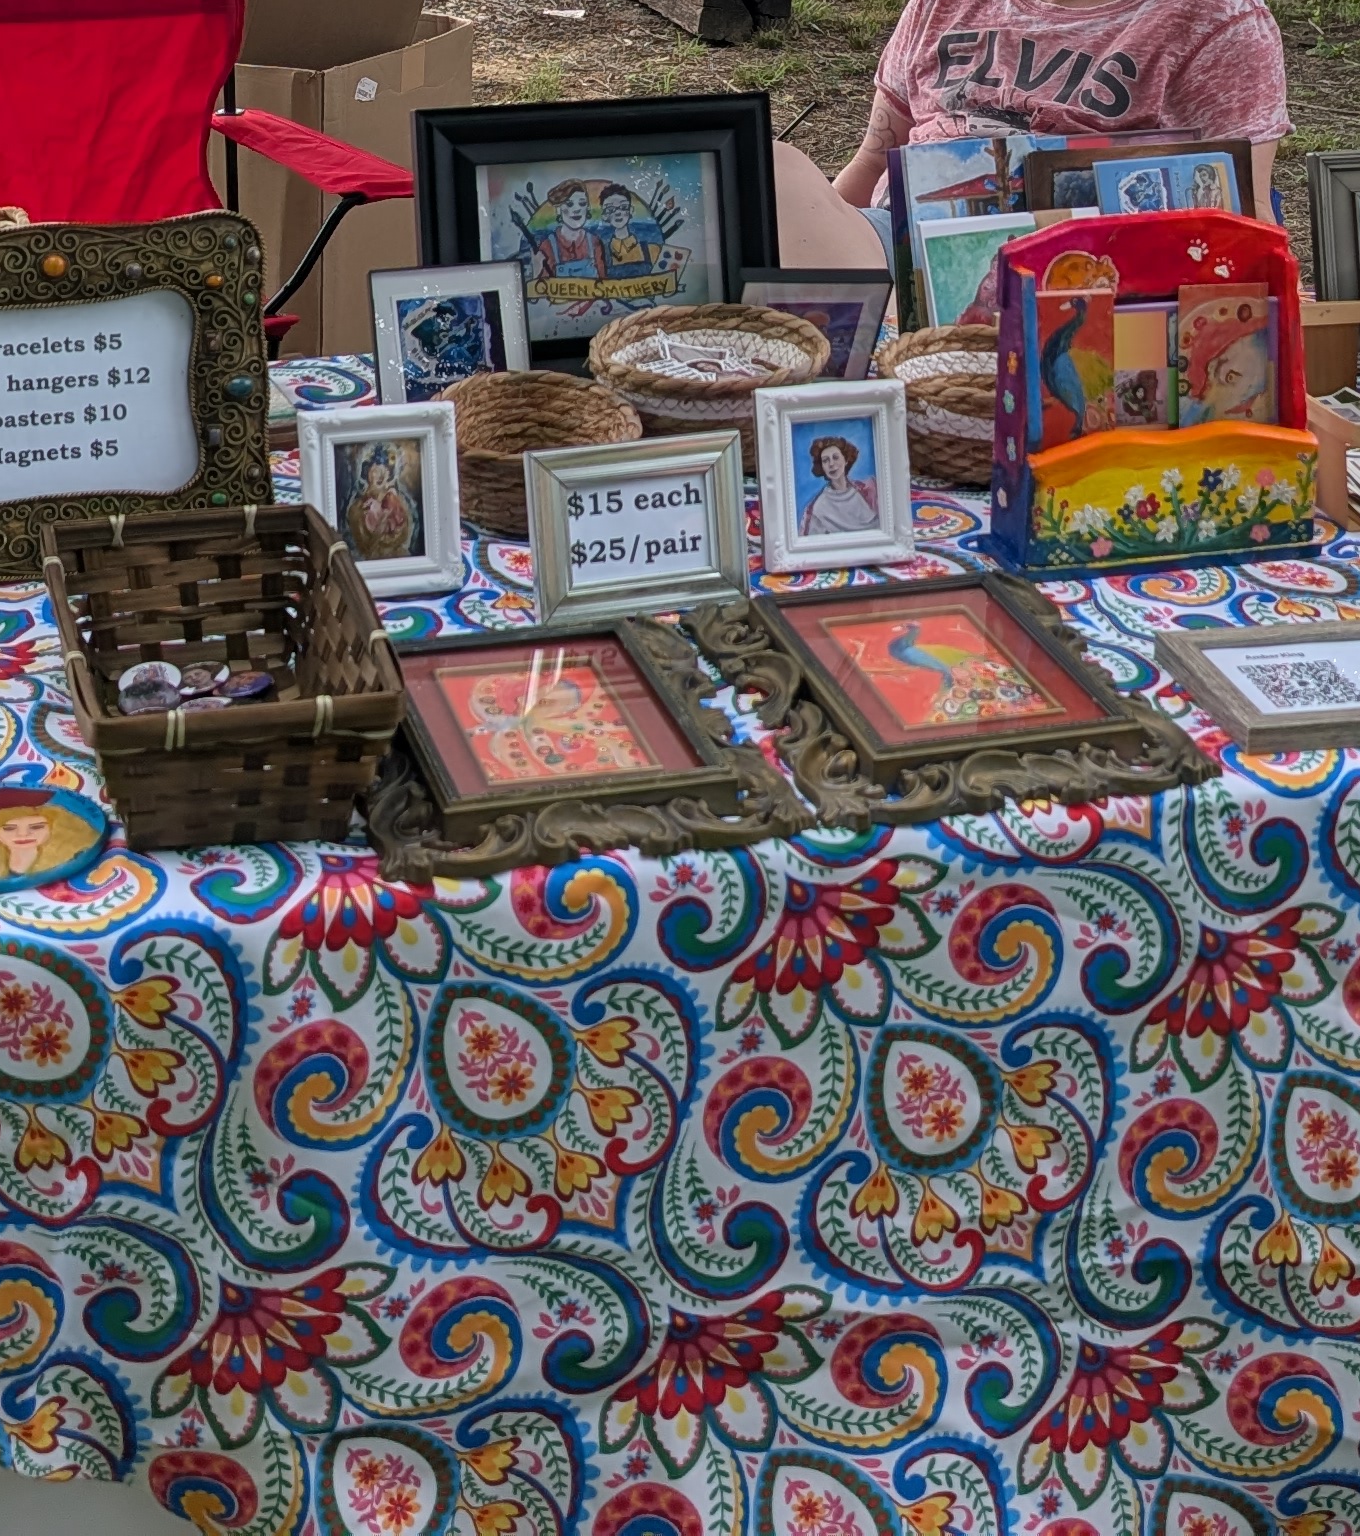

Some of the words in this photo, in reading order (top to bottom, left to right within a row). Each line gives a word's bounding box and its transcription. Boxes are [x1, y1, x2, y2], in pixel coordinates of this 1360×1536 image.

[932, 30, 1138, 118] ELVIS
[535, 277, 588, 296] QUEEN
[592, 277, 669, 298] SMITHERY
[94, 332, 122, 353] $5
[7, 373, 99, 394] hangers
[107, 367, 150, 388] $12
[83, 403, 128, 424] $10
[90, 439, 119, 460] $5
[567, 489, 624, 521] $15
[634, 482, 703, 511] each
[571, 530, 703, 568] $25/pair
